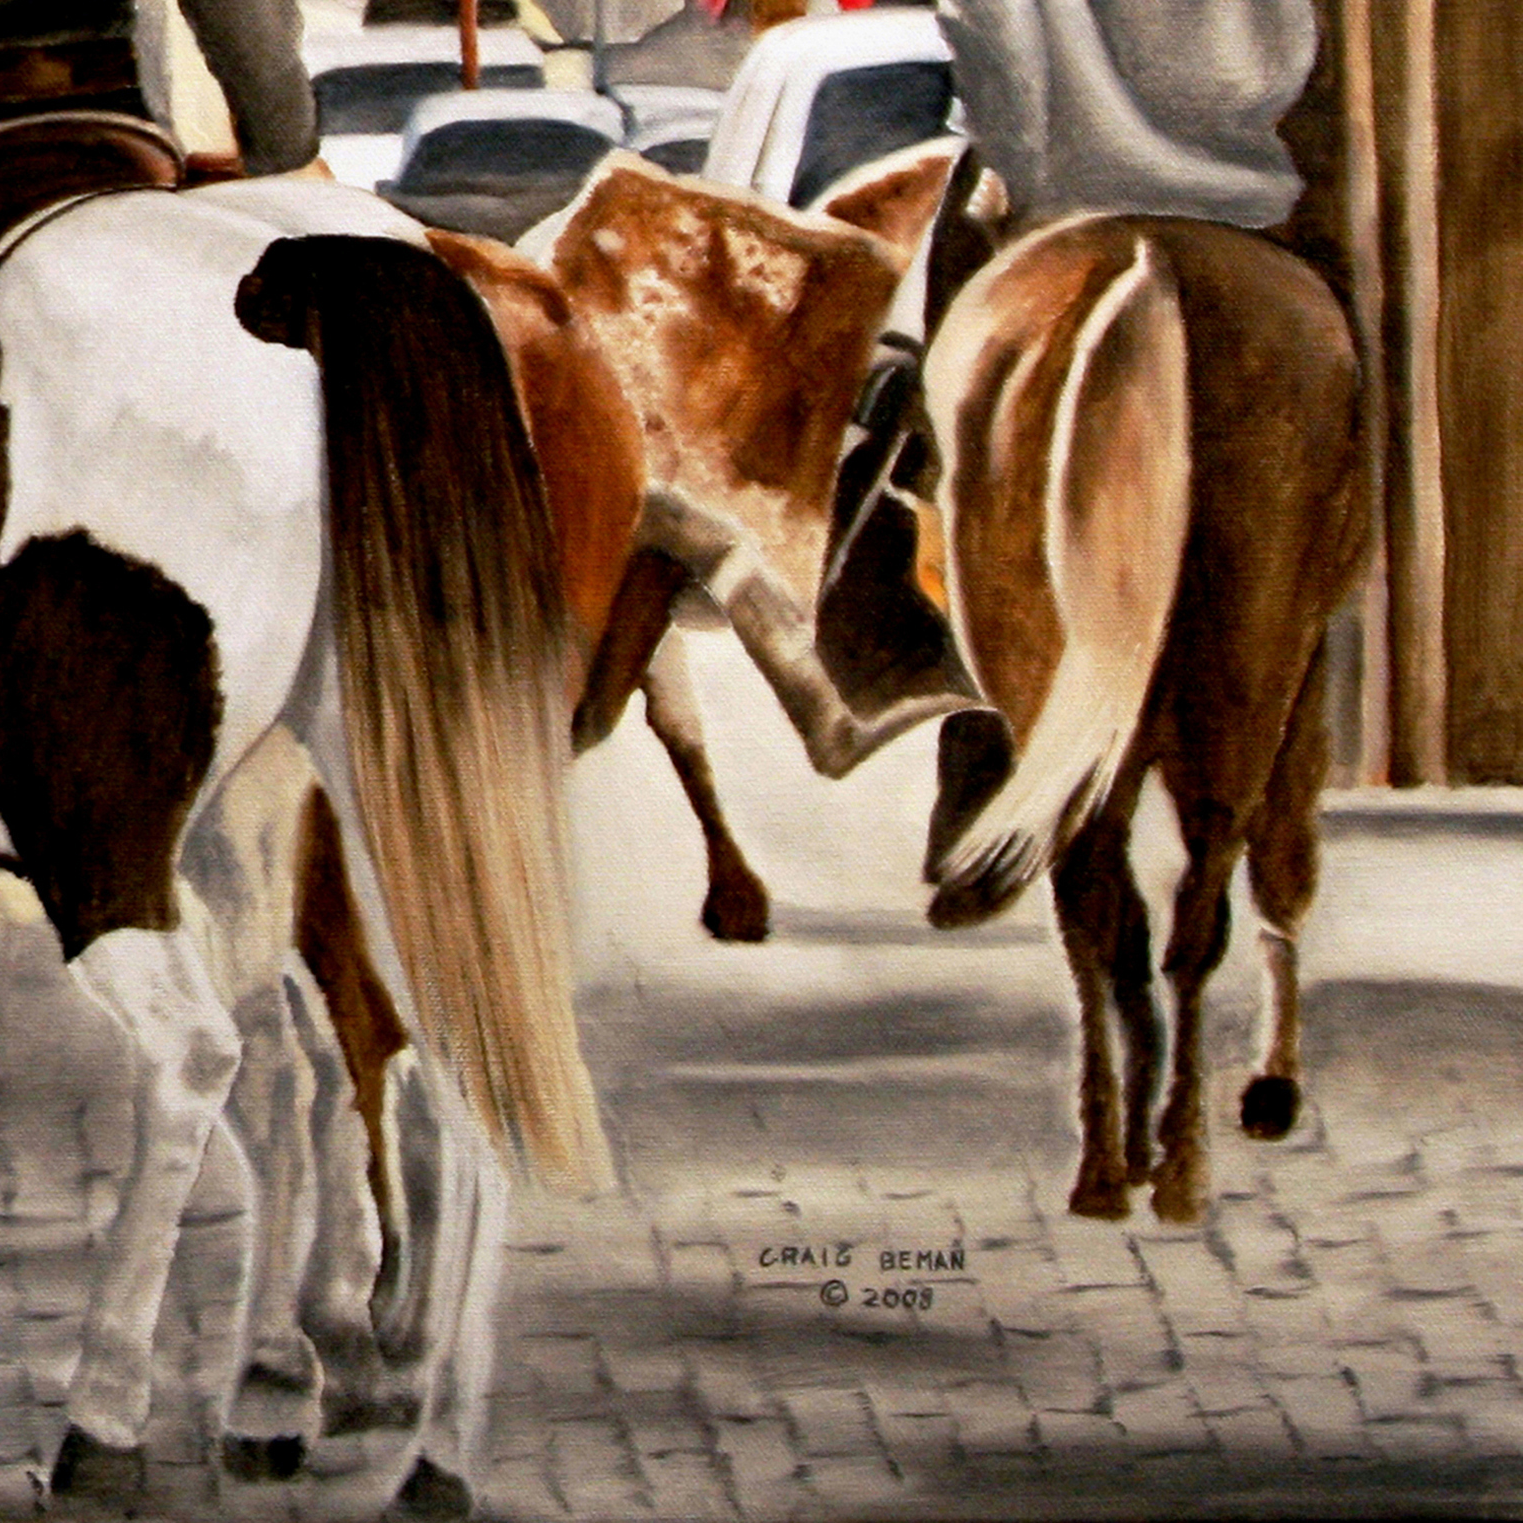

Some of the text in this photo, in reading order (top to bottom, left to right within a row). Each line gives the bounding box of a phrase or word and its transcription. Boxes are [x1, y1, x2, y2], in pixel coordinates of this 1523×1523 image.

[758, 1245, 966, 1272] CRAIG BEMAN
[861, 1287, 934, 1310] 2008
